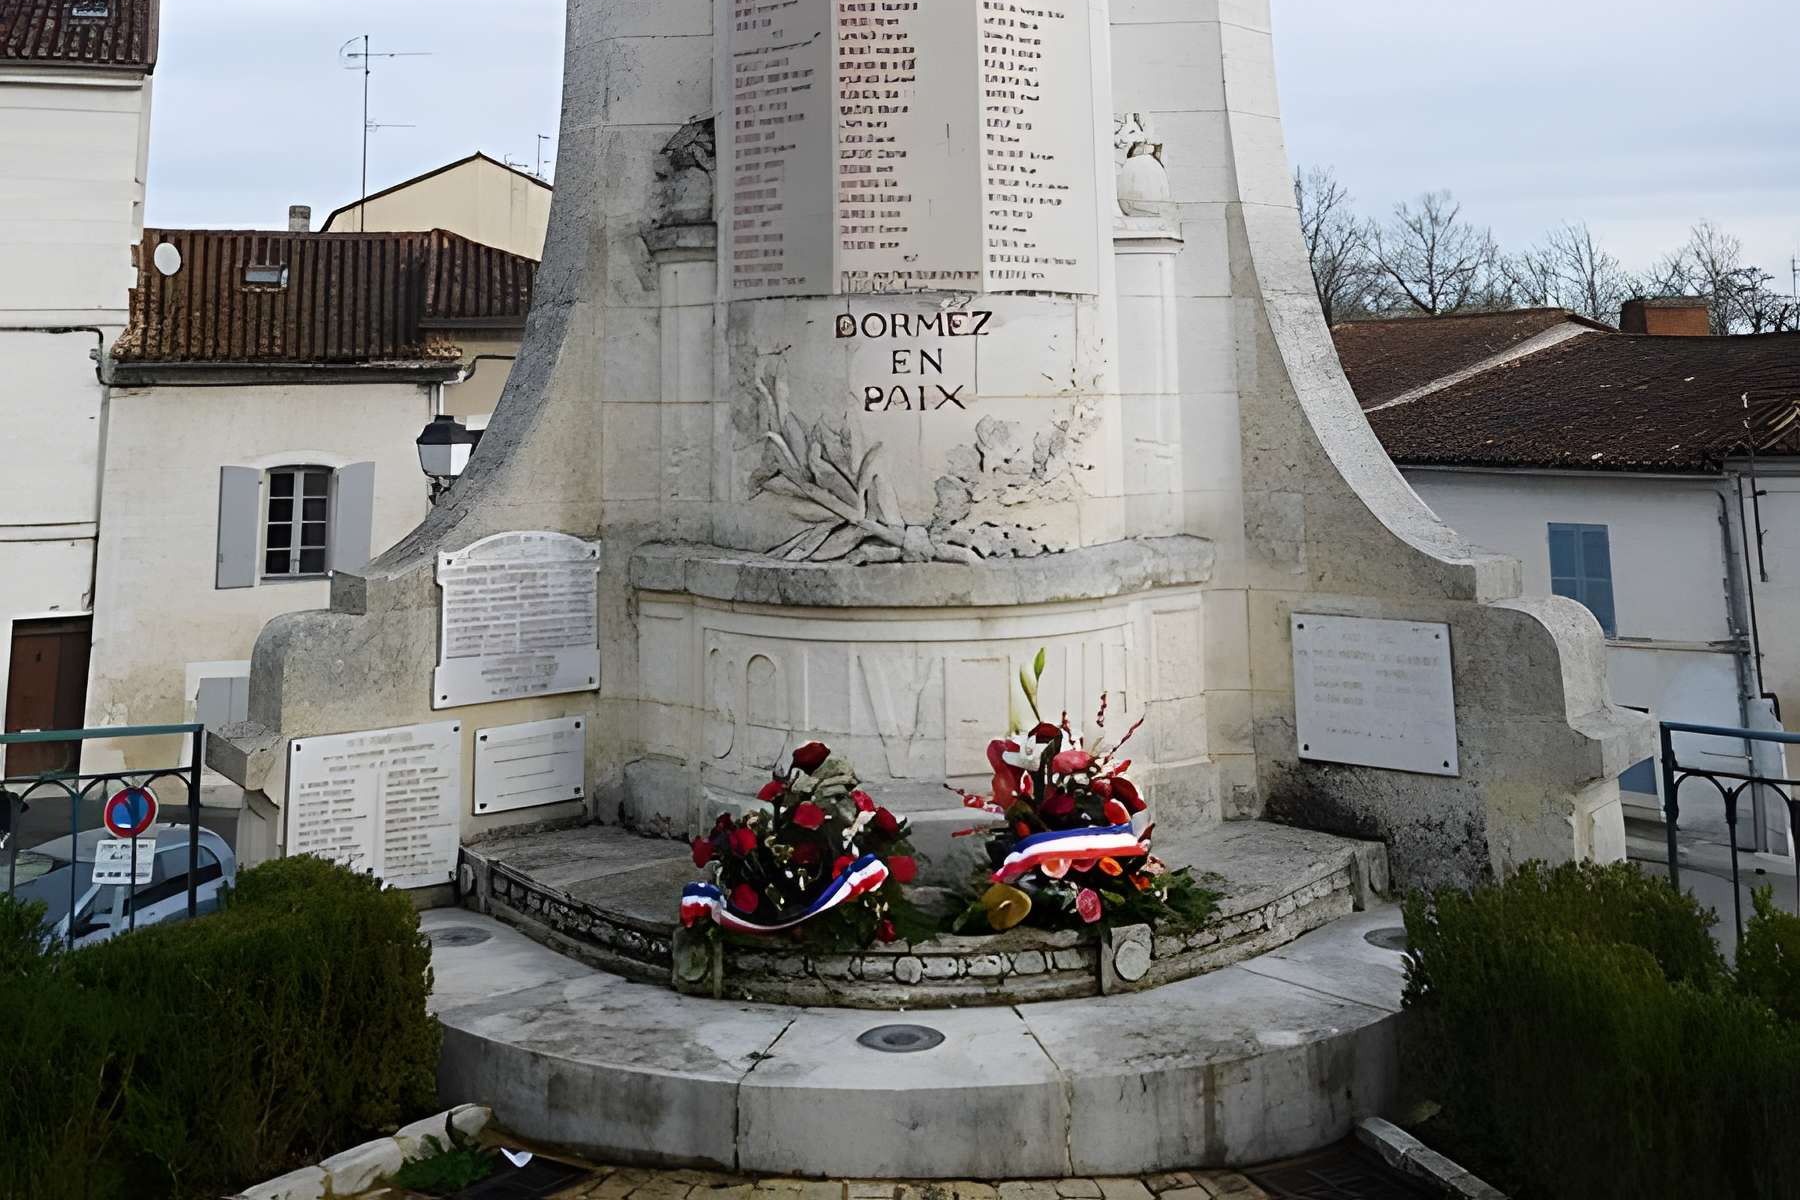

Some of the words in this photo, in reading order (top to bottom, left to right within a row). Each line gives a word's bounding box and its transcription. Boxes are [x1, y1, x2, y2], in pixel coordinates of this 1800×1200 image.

[835, 310, 993, 339] DORMEZ
[891, 348, 943, 375] EN
[863, 384, 967, 412] PAIX
